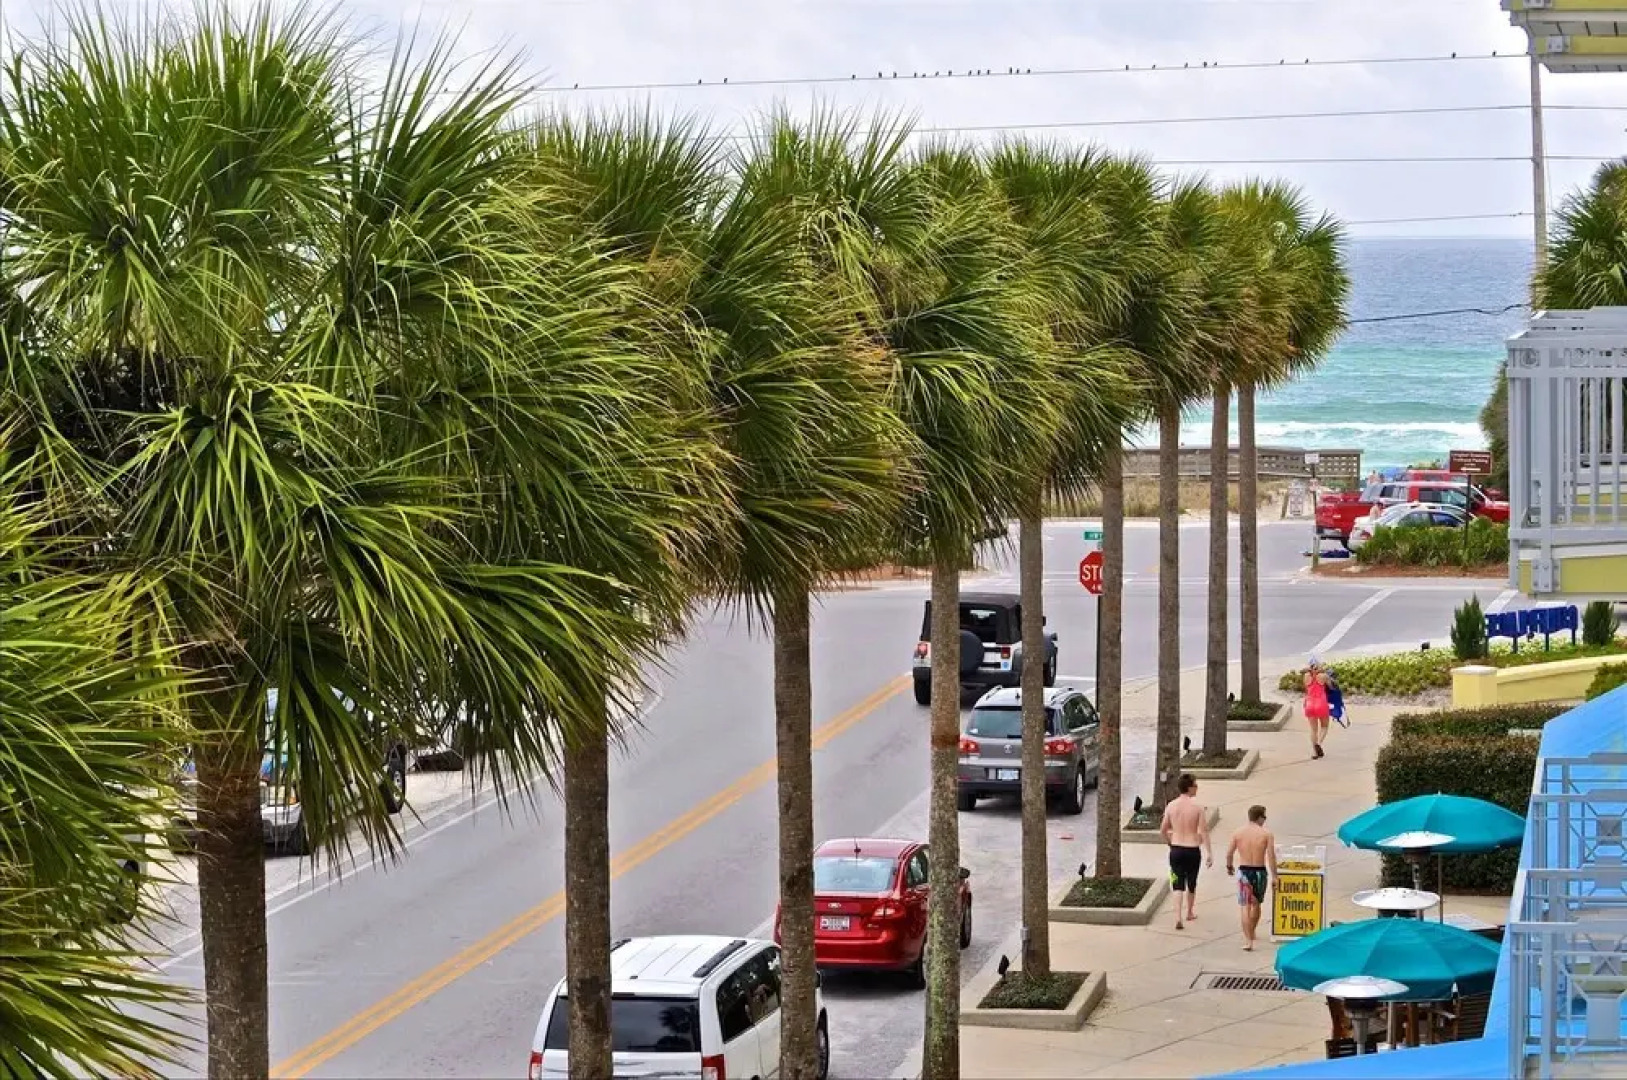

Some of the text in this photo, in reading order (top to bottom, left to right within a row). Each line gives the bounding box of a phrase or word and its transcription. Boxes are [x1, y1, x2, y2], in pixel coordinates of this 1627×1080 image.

[1082, 565, 1103, 581] ST
[1278, 878, 1318, 893] Lunch &
[1281, 895, 1315, 911] Dinner
[1281, 914, 1315, 931] 7 Days
